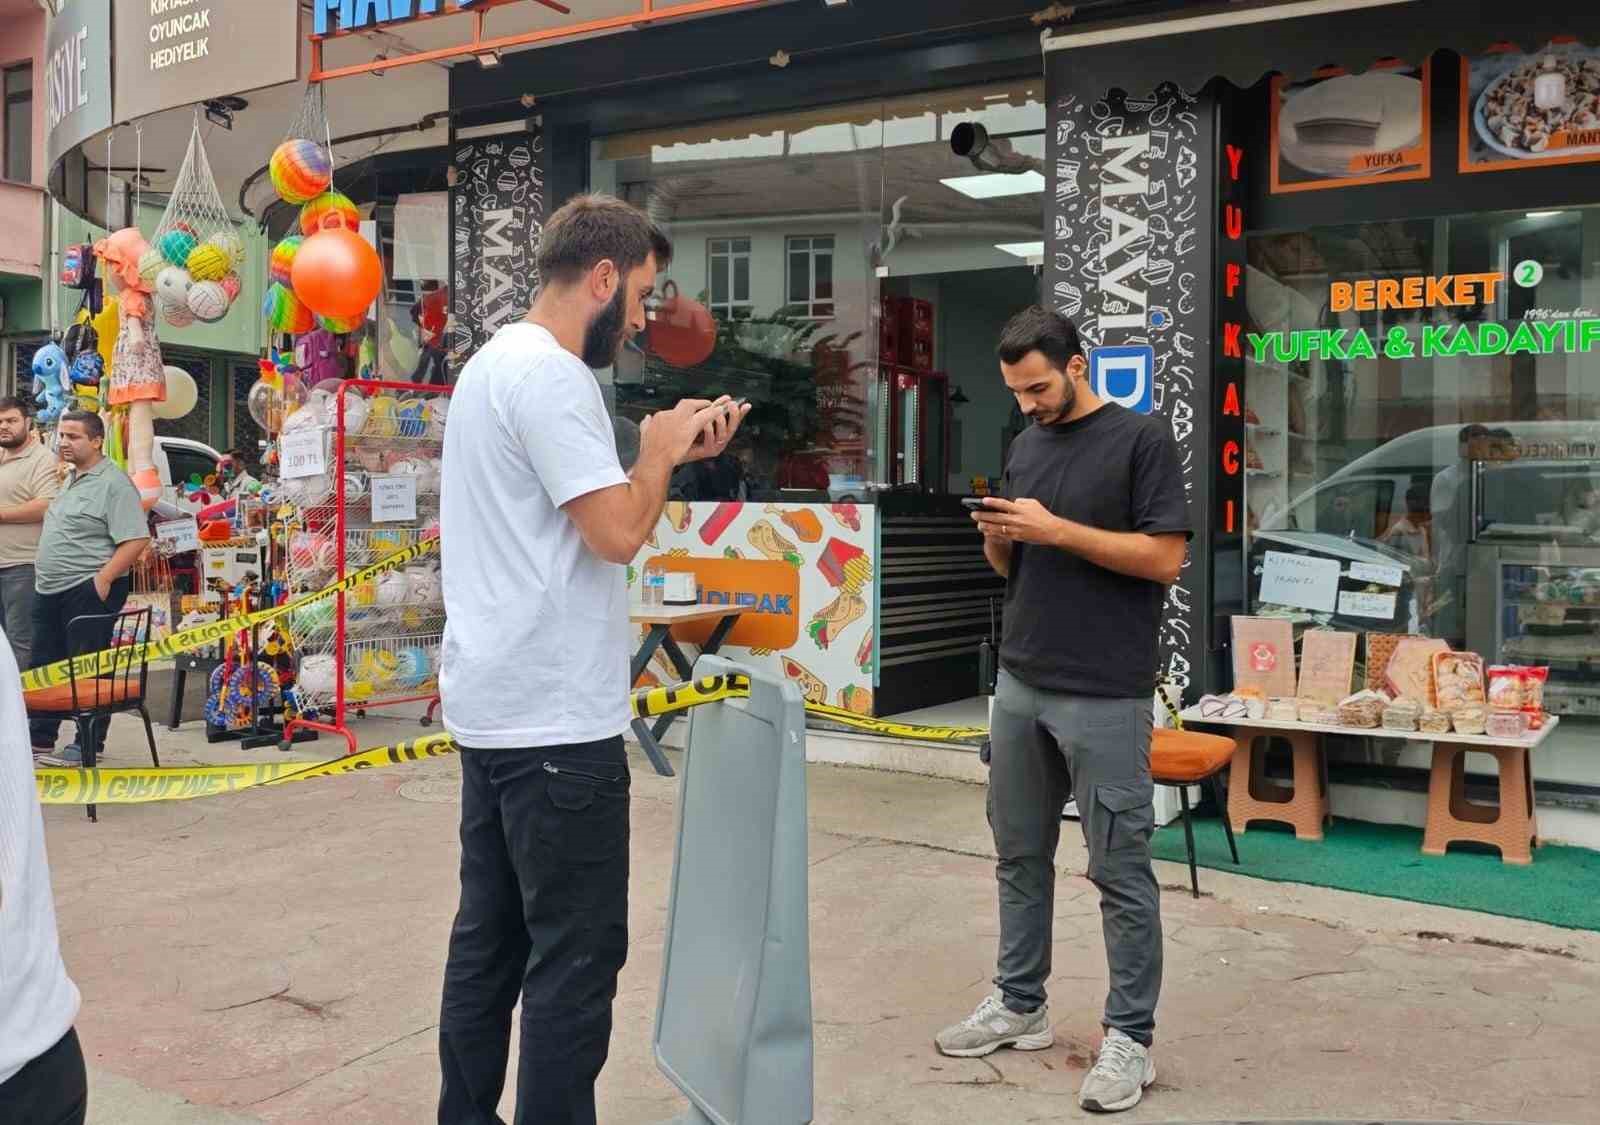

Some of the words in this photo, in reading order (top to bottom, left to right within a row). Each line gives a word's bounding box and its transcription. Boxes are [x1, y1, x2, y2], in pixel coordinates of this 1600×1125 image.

[150, 9, 210, 42] OYUNCAK
[1363, 152, 1404, 168] YUFKA
[1330, 272, 1504, 313] BEREKET
[1223, 144, 1244, 533] YUFKACI
[1247, 329, 1377, 363] YUFKA
[1384, 325, 1415, 359] &
